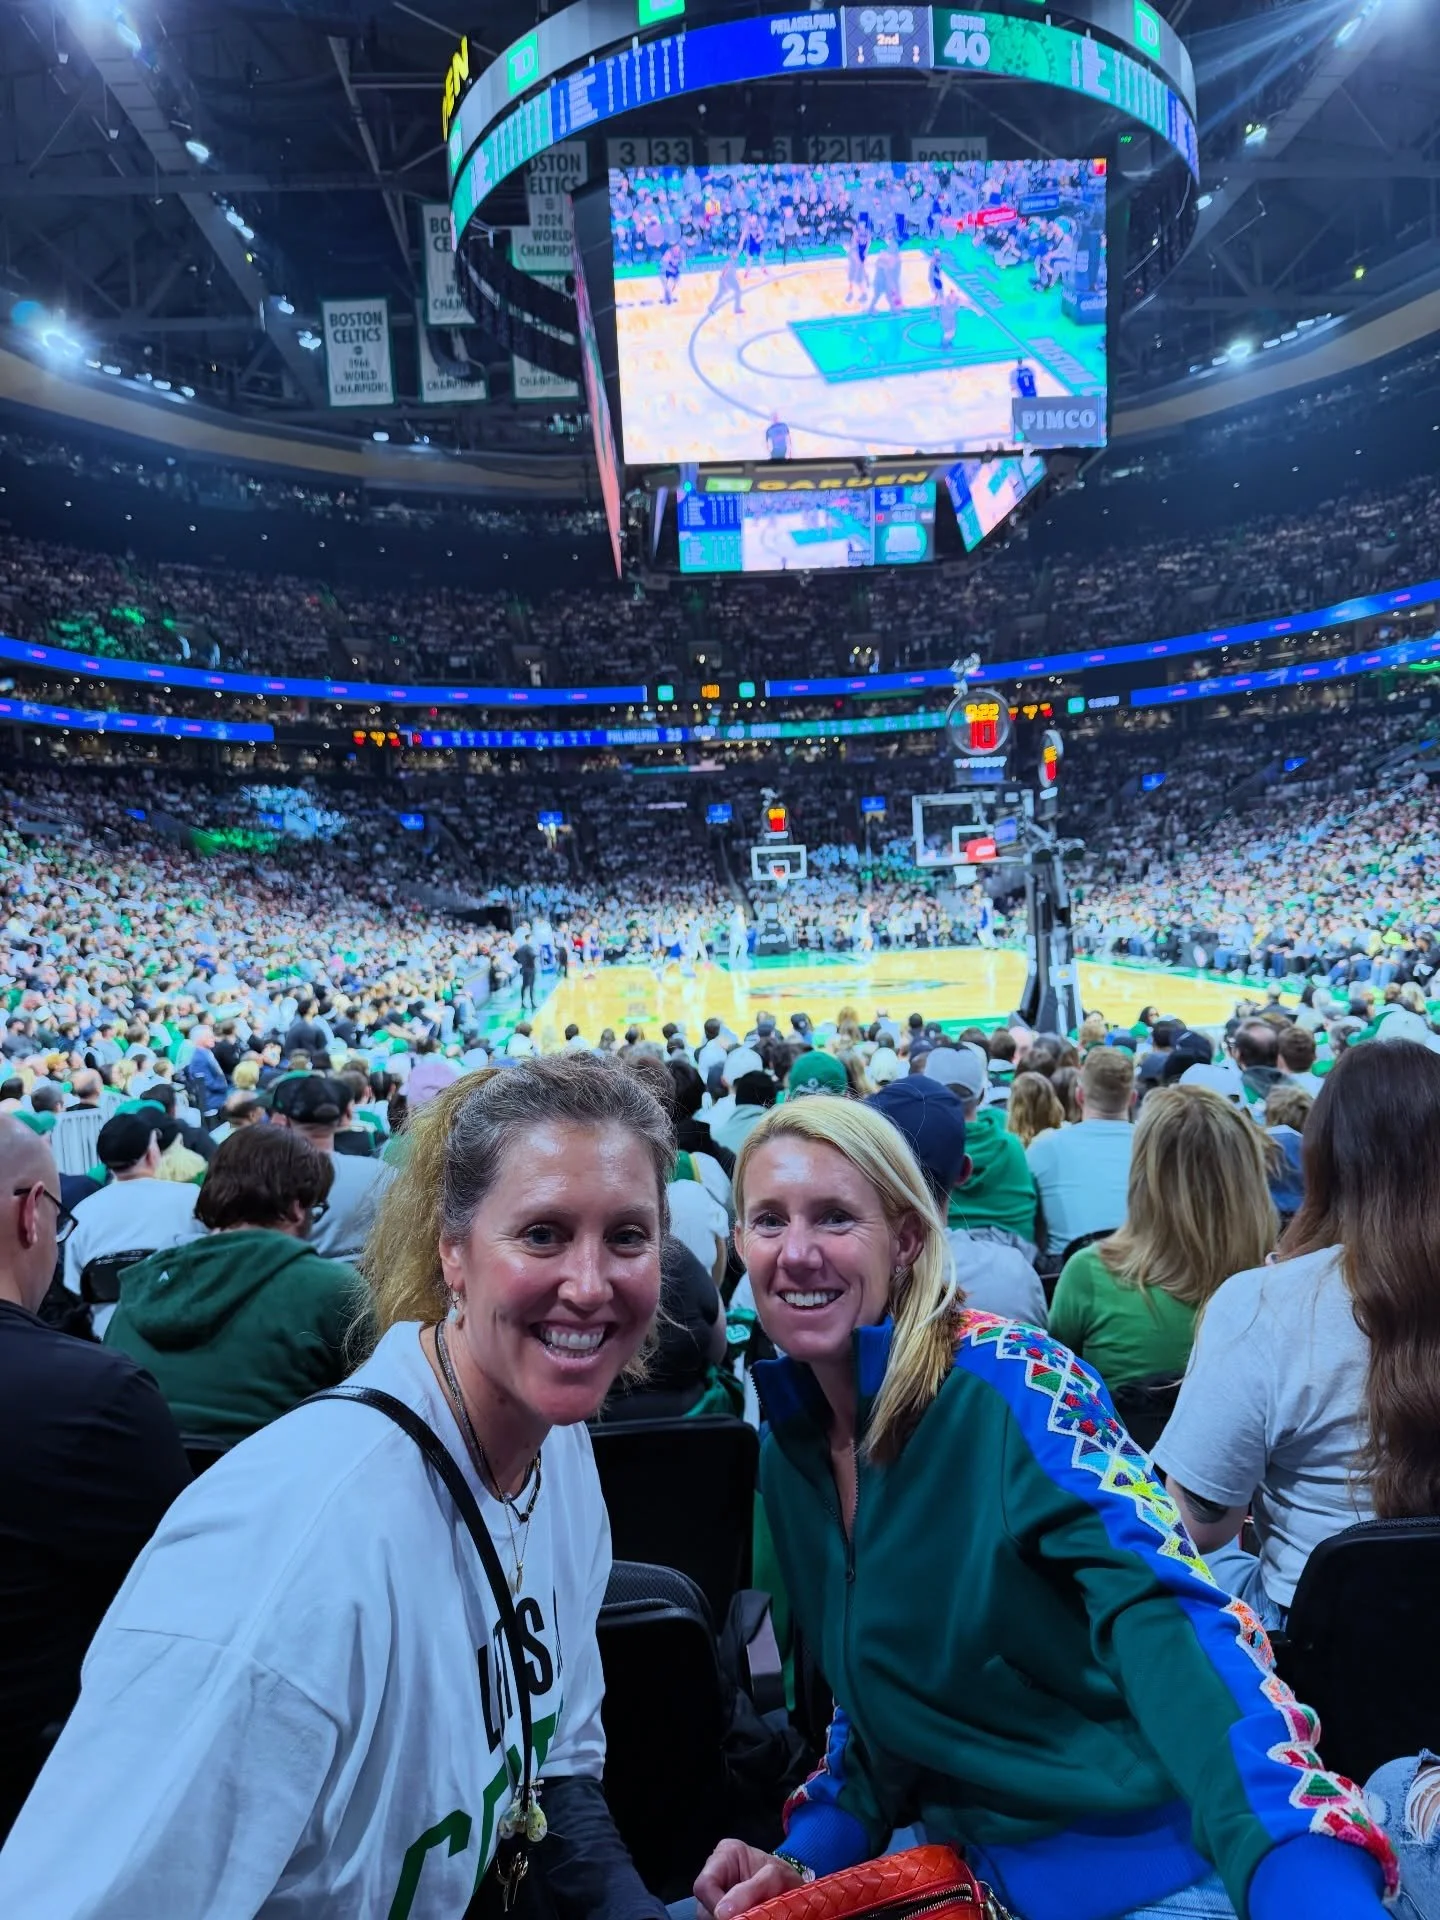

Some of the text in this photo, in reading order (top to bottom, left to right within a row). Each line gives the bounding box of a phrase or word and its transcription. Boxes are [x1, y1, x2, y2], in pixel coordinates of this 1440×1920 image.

[860, 10, 914, 33] 9:22
[782, 31, 829, 67] 25
[876, 33, 900, 46] 2nd
[943, 31, 991, 66] 40
[528, 153, 581, 173] OSTON
[620, 141, 635, 165] 3
[654, 141, 690, 165] 33
[329, 311, 383, 328] BOSTON
[333, 328, 382, 344] CELTICS
[1021, 409, 1097, 430] PIMCO
